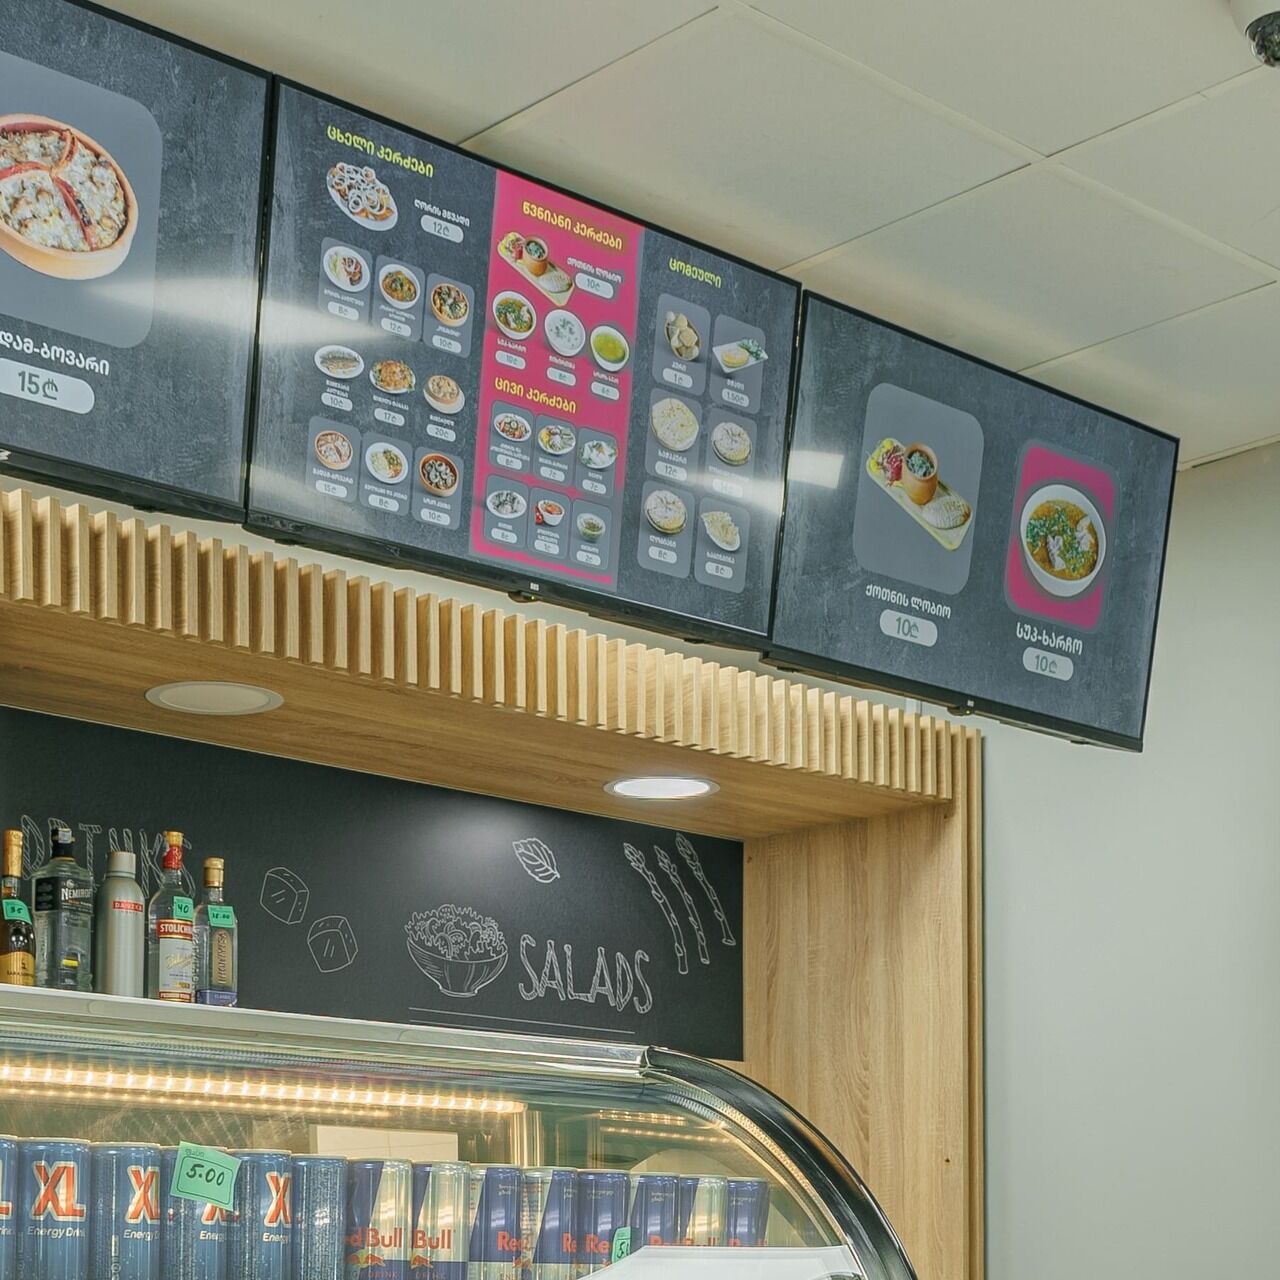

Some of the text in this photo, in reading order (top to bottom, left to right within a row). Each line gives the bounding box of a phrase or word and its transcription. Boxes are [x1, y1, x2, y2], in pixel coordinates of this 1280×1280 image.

[327, 125, 434, 178] ცხელი კერძები
[523, 201, 622, 250] წვნიანი კერძები
[669, 257, 722, 288] ცომეული
[495, 377, 577, 413] ცივი კერძები
[865, 584, 951, 619] ქოთნის ლობიო
[518, 933, 654, 1014] SALADS
[31, 1161, 86, 1222] XL
[186, 1163, 226, 1187] 5.00
[27, 1225, 65, 1239] Energy
[366, 1227, 403, 1248] Bull
[413, 1229, 452, 1250] Bull
